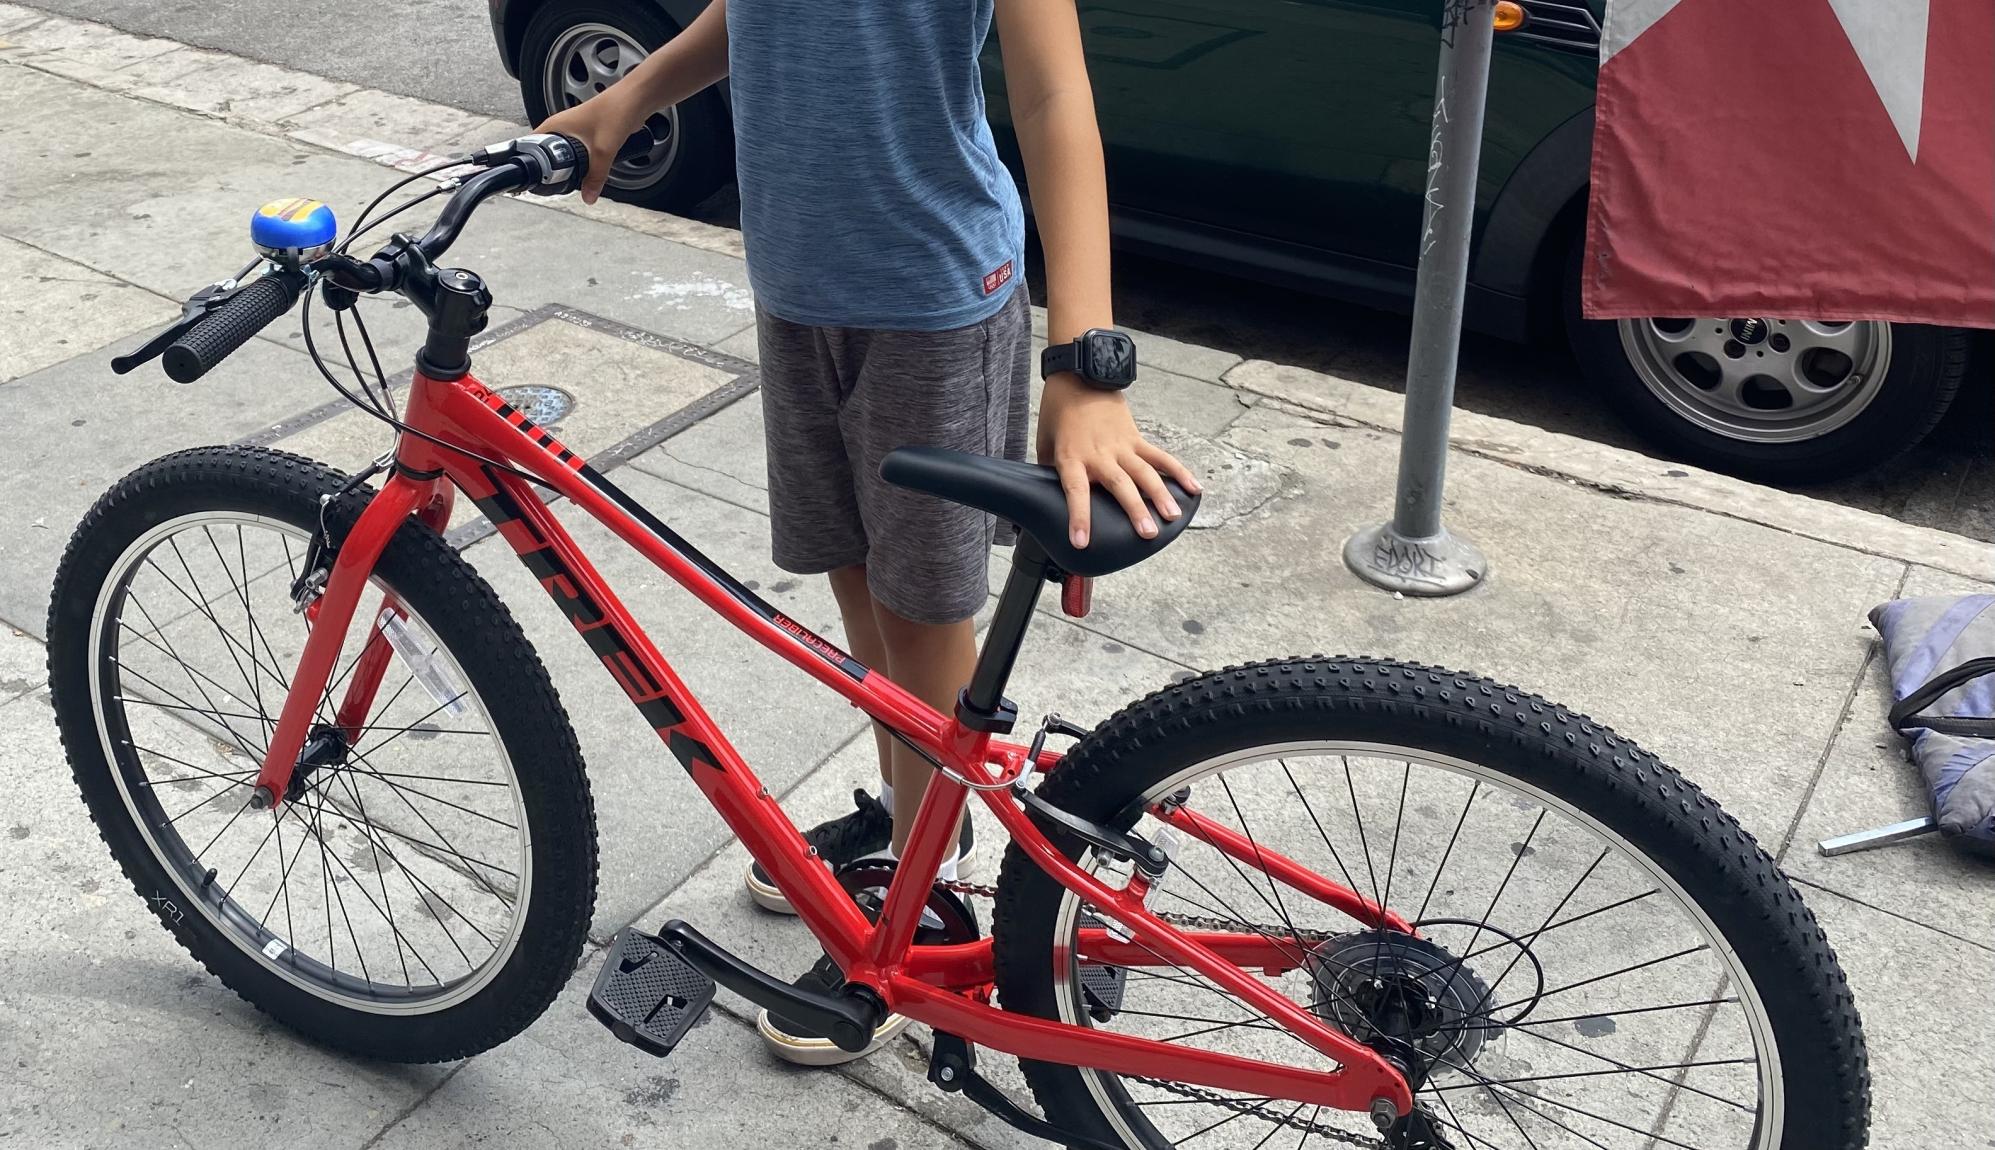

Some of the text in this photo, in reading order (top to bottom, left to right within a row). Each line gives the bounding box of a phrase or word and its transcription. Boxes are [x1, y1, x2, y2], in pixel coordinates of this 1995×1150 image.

[999, 267, 1012, 283] USA
[474, 463, 729, 776] TREK
[772, 613, 847, 665] PRECALIBER
[151, 889, 184, 927] XR1
